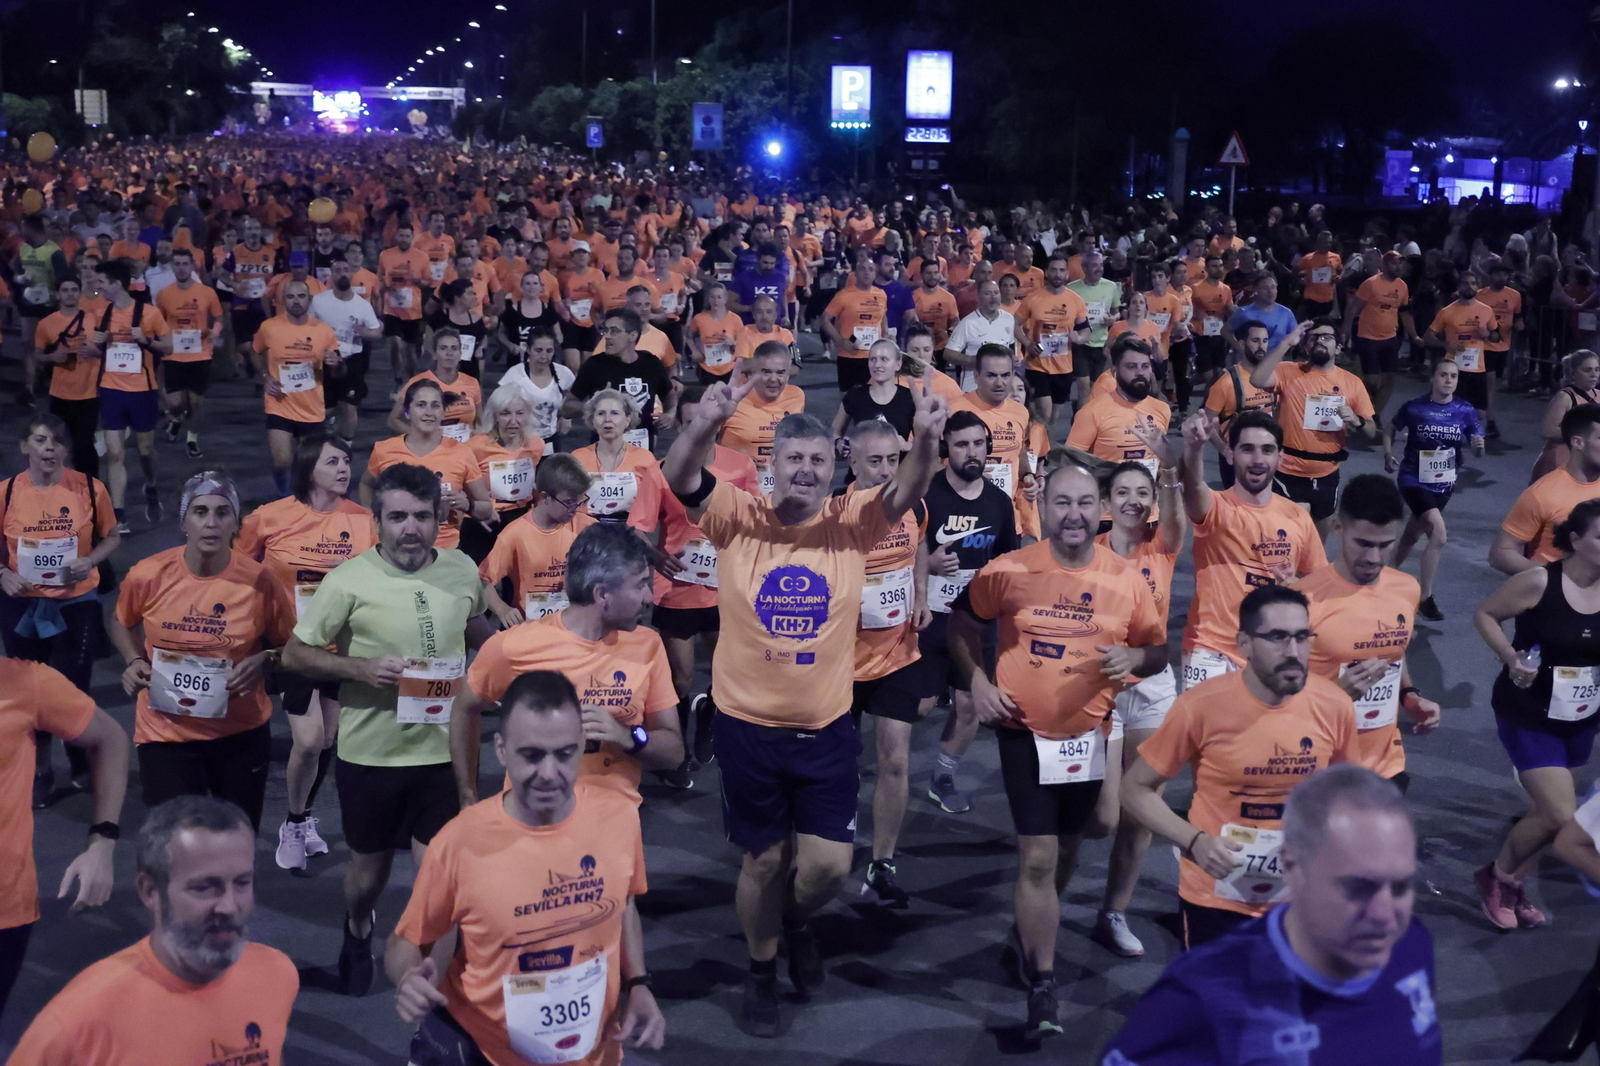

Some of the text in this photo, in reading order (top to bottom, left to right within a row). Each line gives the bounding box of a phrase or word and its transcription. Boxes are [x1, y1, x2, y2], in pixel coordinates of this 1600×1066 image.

[842, 71, 864, 101] P
[590, 126, 599, 136] P
[908, 128, 947, 139] 22:05
[240, 264, 269, 273] ZPTG
[114, 352, 135, 361] 11773
[1314, 406, 1338, 417] 21596
[1417, 424, 1462, 435] CARRERA
[502, 472, 528, 485] 15617
[600, 486, 624, 498] 3041
[944, 515, 979, 532] JUST
[880, 533, 910, 542] OCTURNA
[300, 546, 333, 555] SEVILLA
[35, 555, 64, 567] 6967
[690, 553, 717, 568] 2151
[760, 594, 827, 604] LA NOCTURNA
[879, 587, 906, 605] 3368
[1033, 608, 1070, 620] SEVILLA
[1052, 604, 1094, 614] NOCTURNA
[161, 621, 201, 632] SEVILLA
[182, 616, 227, 627] NOCTURNA
[1373, 630, 1409, 640] NOCTURNA
[1354, 639, 1391, 649] SEVILLA
[1184, 665, 1207, 682] 5393
[174, 672, 211, 692] 6966
[427, 681, 452, 698] 780
[584, 688, 633, 697] NOCTURNA
[1572, 685, 1599, 699] 7255
[1059, 741, 1090, 757] 4847
[1267, 756, 1317, 766] NOCTURNA
[1243, 766, 1291, 776] SEVILLA
[1246, 854, 1283, 875] 774
[542, 876, 605, 898] NOCTURNA
[514, 896, 571, 917] SEVILLA
[540, 994, 591, 1027] 3305
